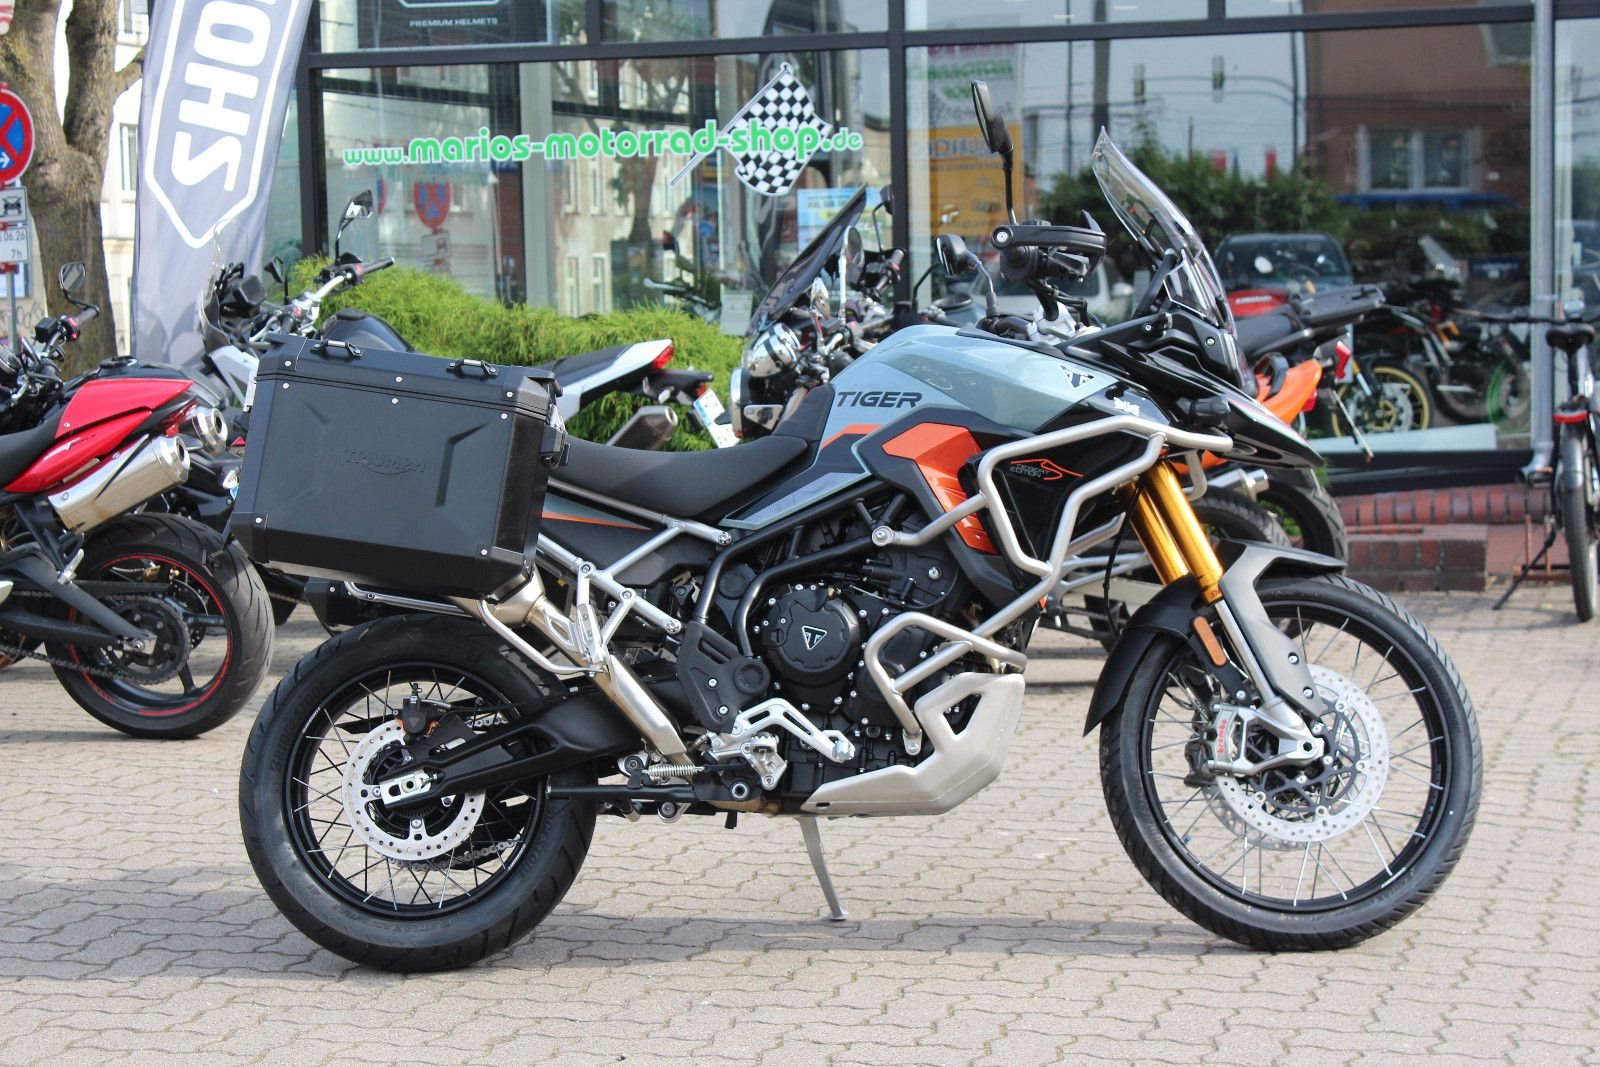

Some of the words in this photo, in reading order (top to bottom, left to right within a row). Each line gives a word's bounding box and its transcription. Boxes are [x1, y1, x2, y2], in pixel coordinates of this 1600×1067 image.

[410, 18, 453, 28] PREMIUM
[455, 17, 498, 26] HELMETS
[171, 0, 277, 191] SHO
[837, 391, 922, 408] TIGER
[1216, 719, 1228, 753] brembo
